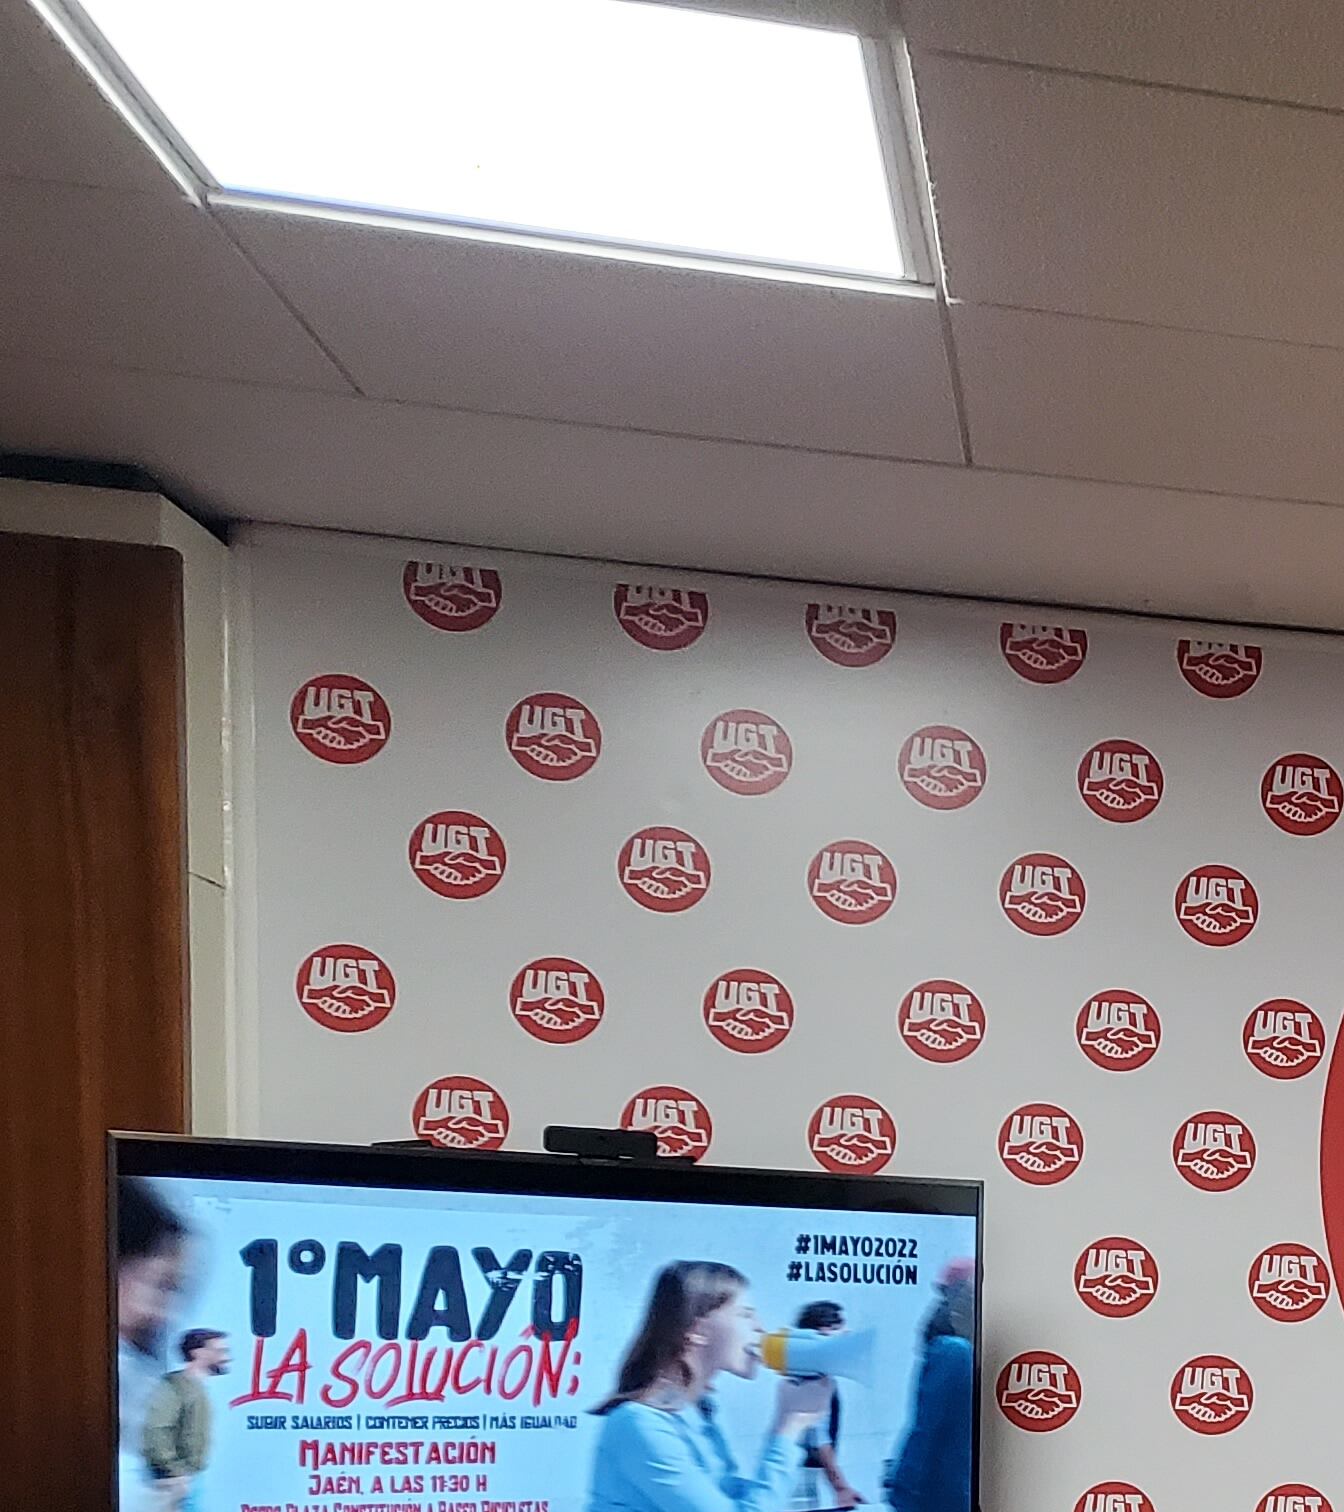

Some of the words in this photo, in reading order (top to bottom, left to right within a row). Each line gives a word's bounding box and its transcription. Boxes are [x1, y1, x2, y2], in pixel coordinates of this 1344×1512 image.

[305, 686, 377, 719] UGT
[1090, 751, 1151, 781] UGT
[1274, 764, 1331, 795] UGT
[423, 822, 492, 855] UGT
[631, 839, 700, 870] UGT
[1187, 875, 1247, 906] UGT
[310, 955, 380, 988] UGT
[524, 969, 591, 1001] UGT
[717, 980, 781, 1011] UGT
[1089, 999, 1149, 1030] UGT
[821, 1105, 884, 1135] UGT
[1011, 1114, 1072, 1144] UGT
[1185, 1121, 1245, 1151] UGT
[795, 1233, 918, 1261] #1MAYO2022
[786, 1258, 918, 1286] #LASOLUCIÓN
[229, 1327, 311, 1410] LA
[1009, 1361, 1069, 1392] UGT
[1183, 1365, 1242, 1395] UGT
[246, 1415, 287, 1430] SUBIR
[290, 1415, 353, 1430] SALARIOS
[365, 1415, 429, 1430] CONTENER
[432, 1415, 480, 1430] PRECIOS
[489, 1412, 516, 1430] MÁS
[519, 1415, 577, 1430] IGUALDAD
[371, 1476, 383, 1494] A
[390, 1475, 424, 1494] LAS
[431, 1474, 470, 1493] 11:30
[476, 1474, 488, 1492] H
